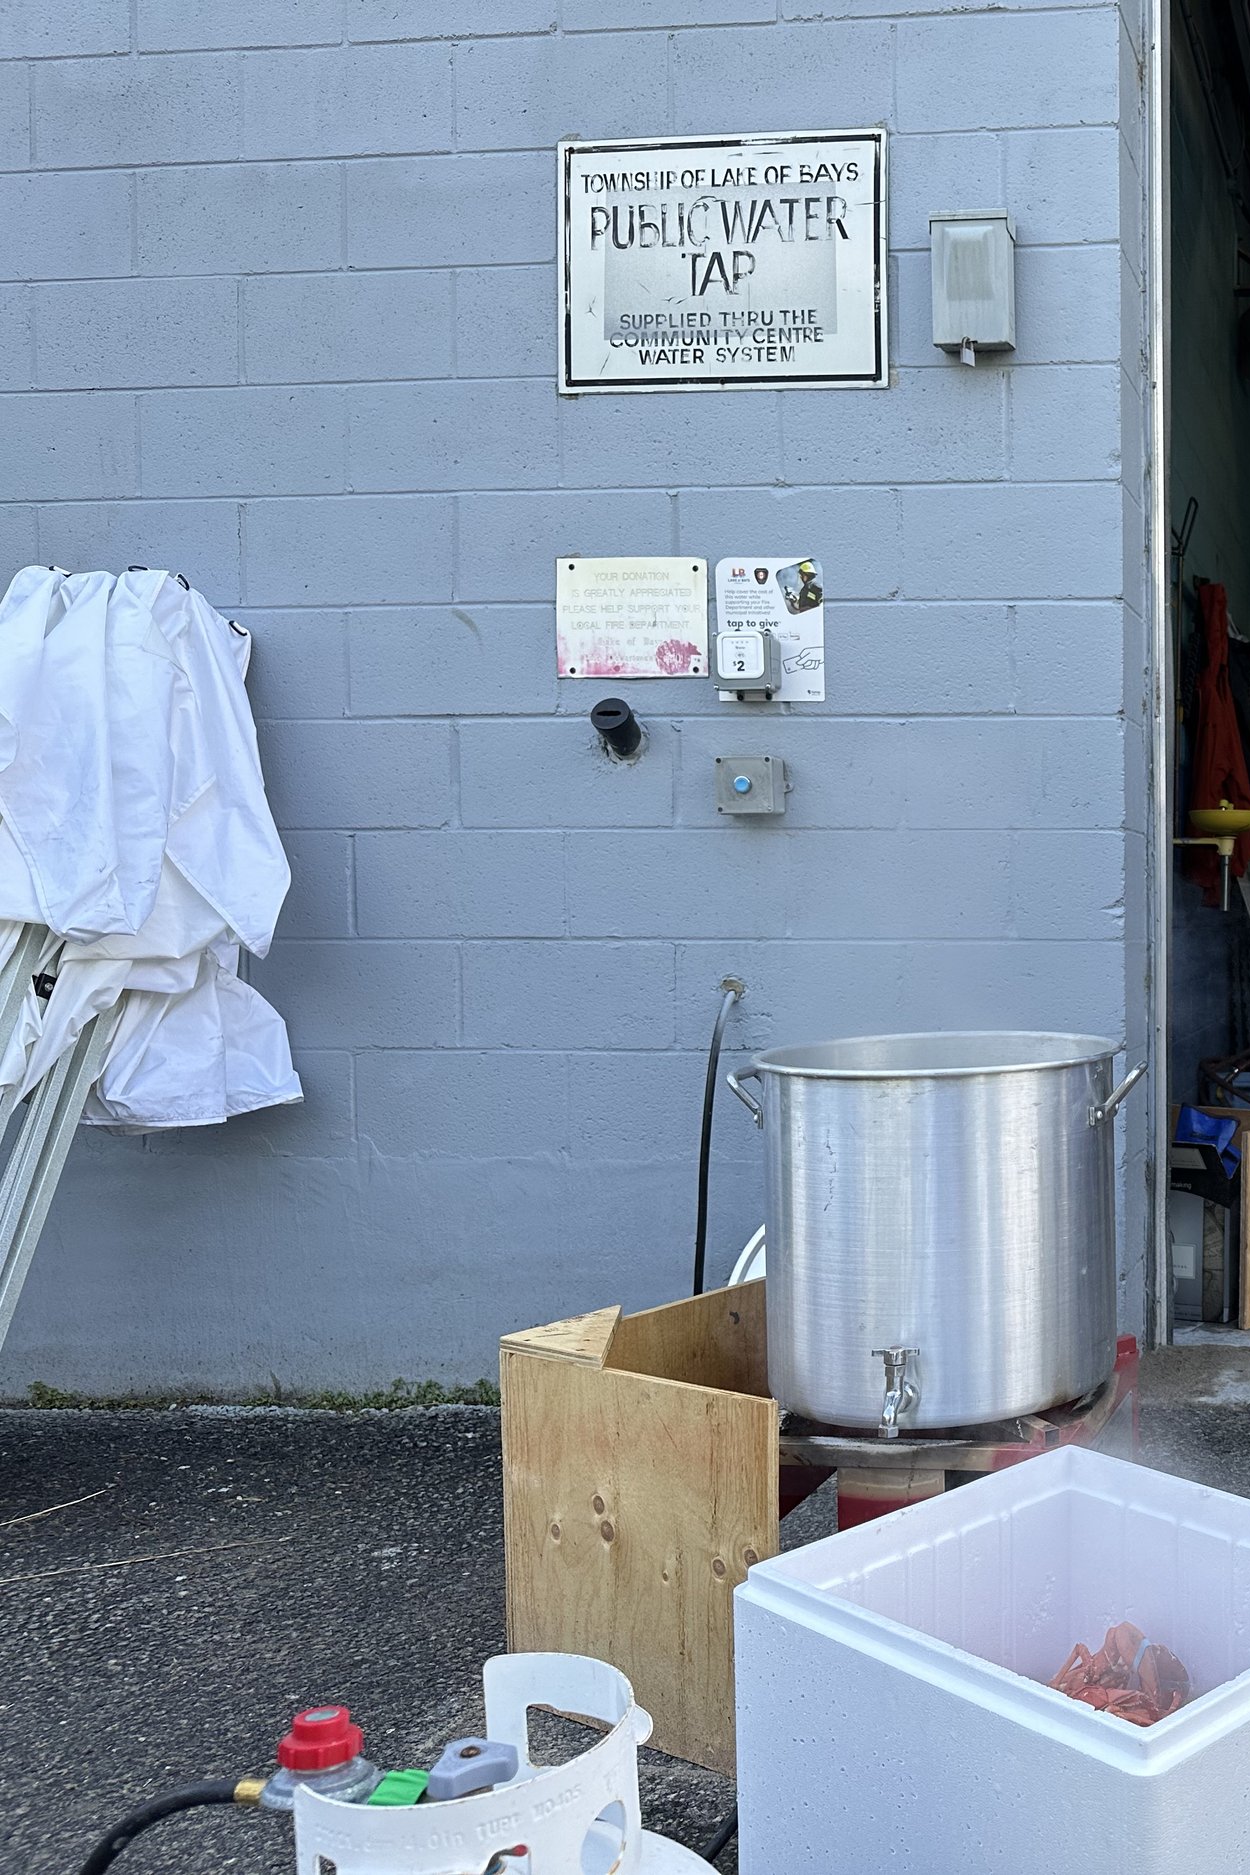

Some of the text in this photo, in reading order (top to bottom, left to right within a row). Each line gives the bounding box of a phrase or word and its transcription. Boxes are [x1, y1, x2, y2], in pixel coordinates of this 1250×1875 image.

[580, 162, 859, 194] TOWNSHIP OF LAKE OF BAYS
[590, 195, 850, 250] PUBLIC WATER
[681, 250, 756, 297] TAP
[620, 309, 818, 330] SUPPLIED THRU THE
[609, 326, 824, 348] COMMUNITY CENTRE
[638, 346, 796, 365] WATER SYSTEM
[594, 571, 670, 582] YOUR DONATION
[571, 588, 692, 598] IS GREATLY APPRECIATED
[562, 604, 701, 614] PLEASE HELP SUPPORT YOUR
[571, 620, 690, 630] LOCAL FIRE DEPARTMENT
[726, 618, 780, 630] tap to give
[732, 660, 746, 672] $2
